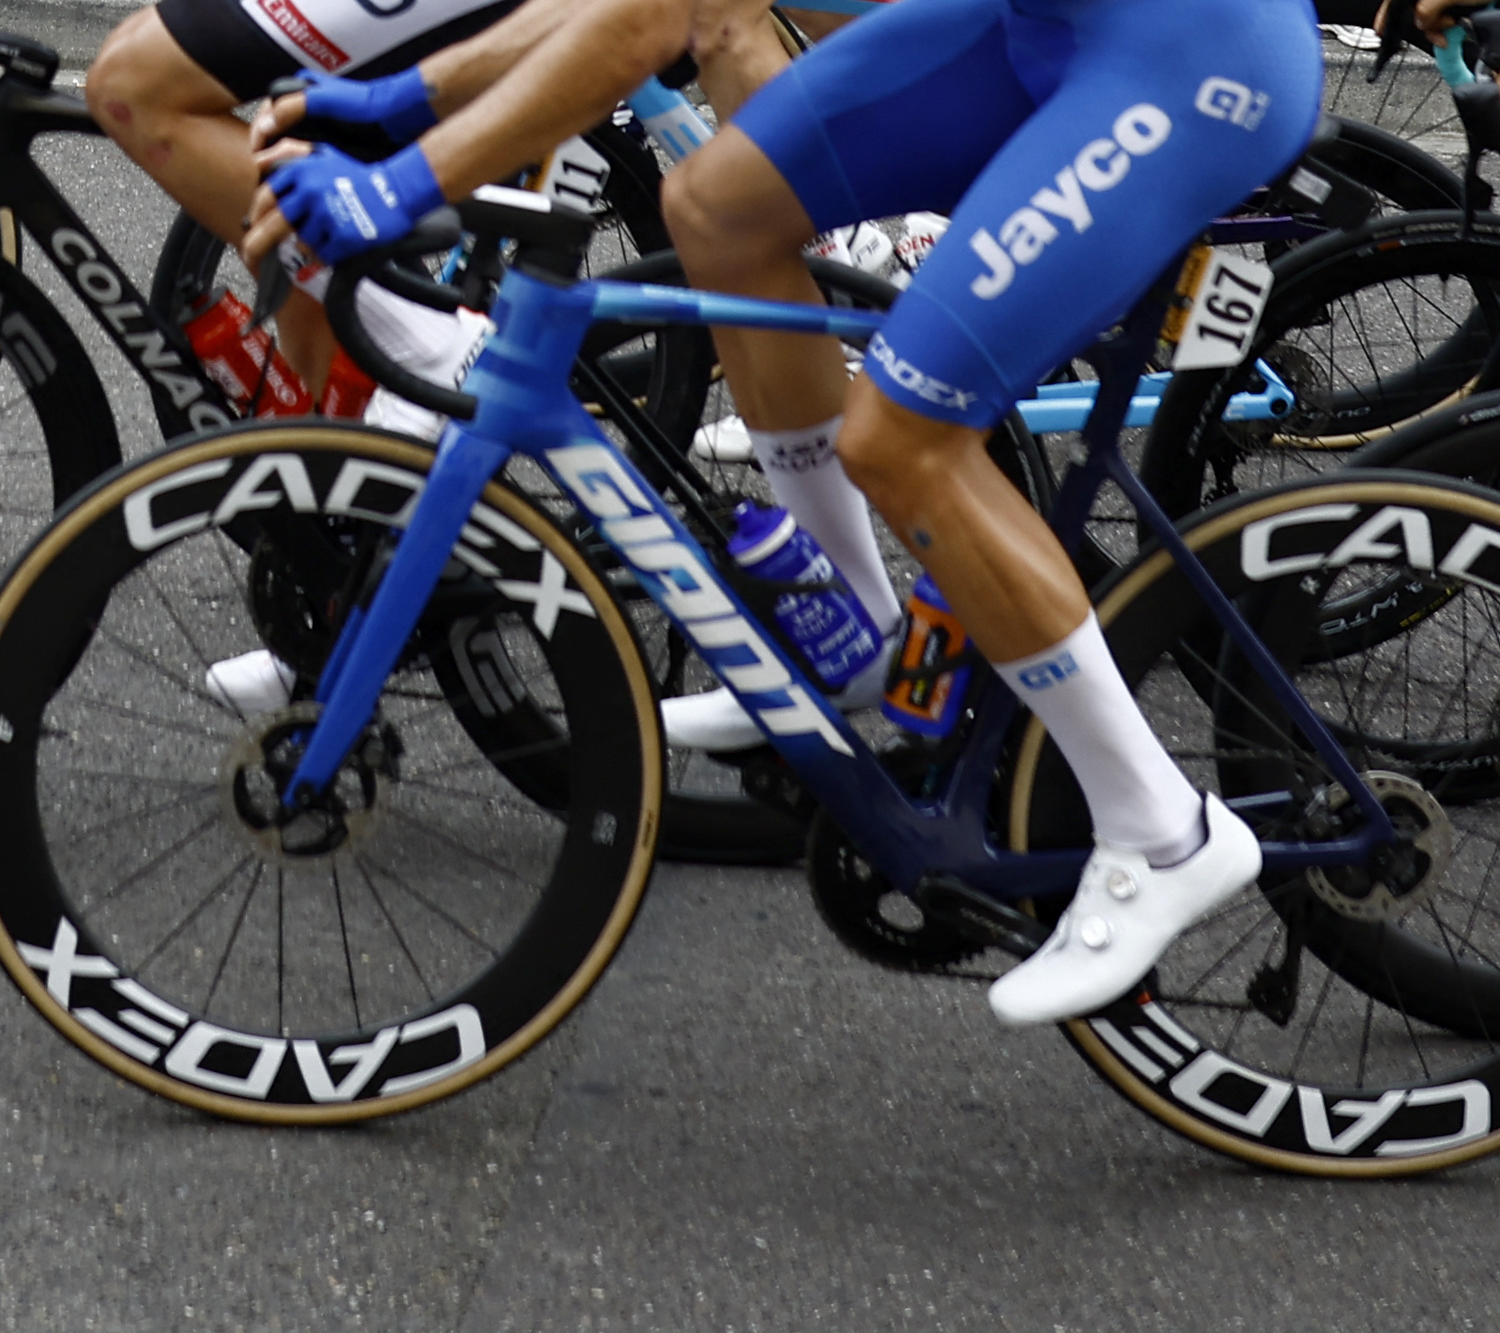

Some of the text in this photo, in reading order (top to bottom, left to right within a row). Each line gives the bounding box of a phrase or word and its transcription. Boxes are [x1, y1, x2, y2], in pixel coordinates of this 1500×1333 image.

[553, 160, 607, 213] 11
[968, 101, 1173, 301] Jayco
[1201, 262, 1266, 355] 167
[123, 453, 597, 640] CADEX
[544, 443, 855, 757] GIANT
[15, 915, 487, 1103] CADEX
[1092, 998, 1494, 1157] CADE
